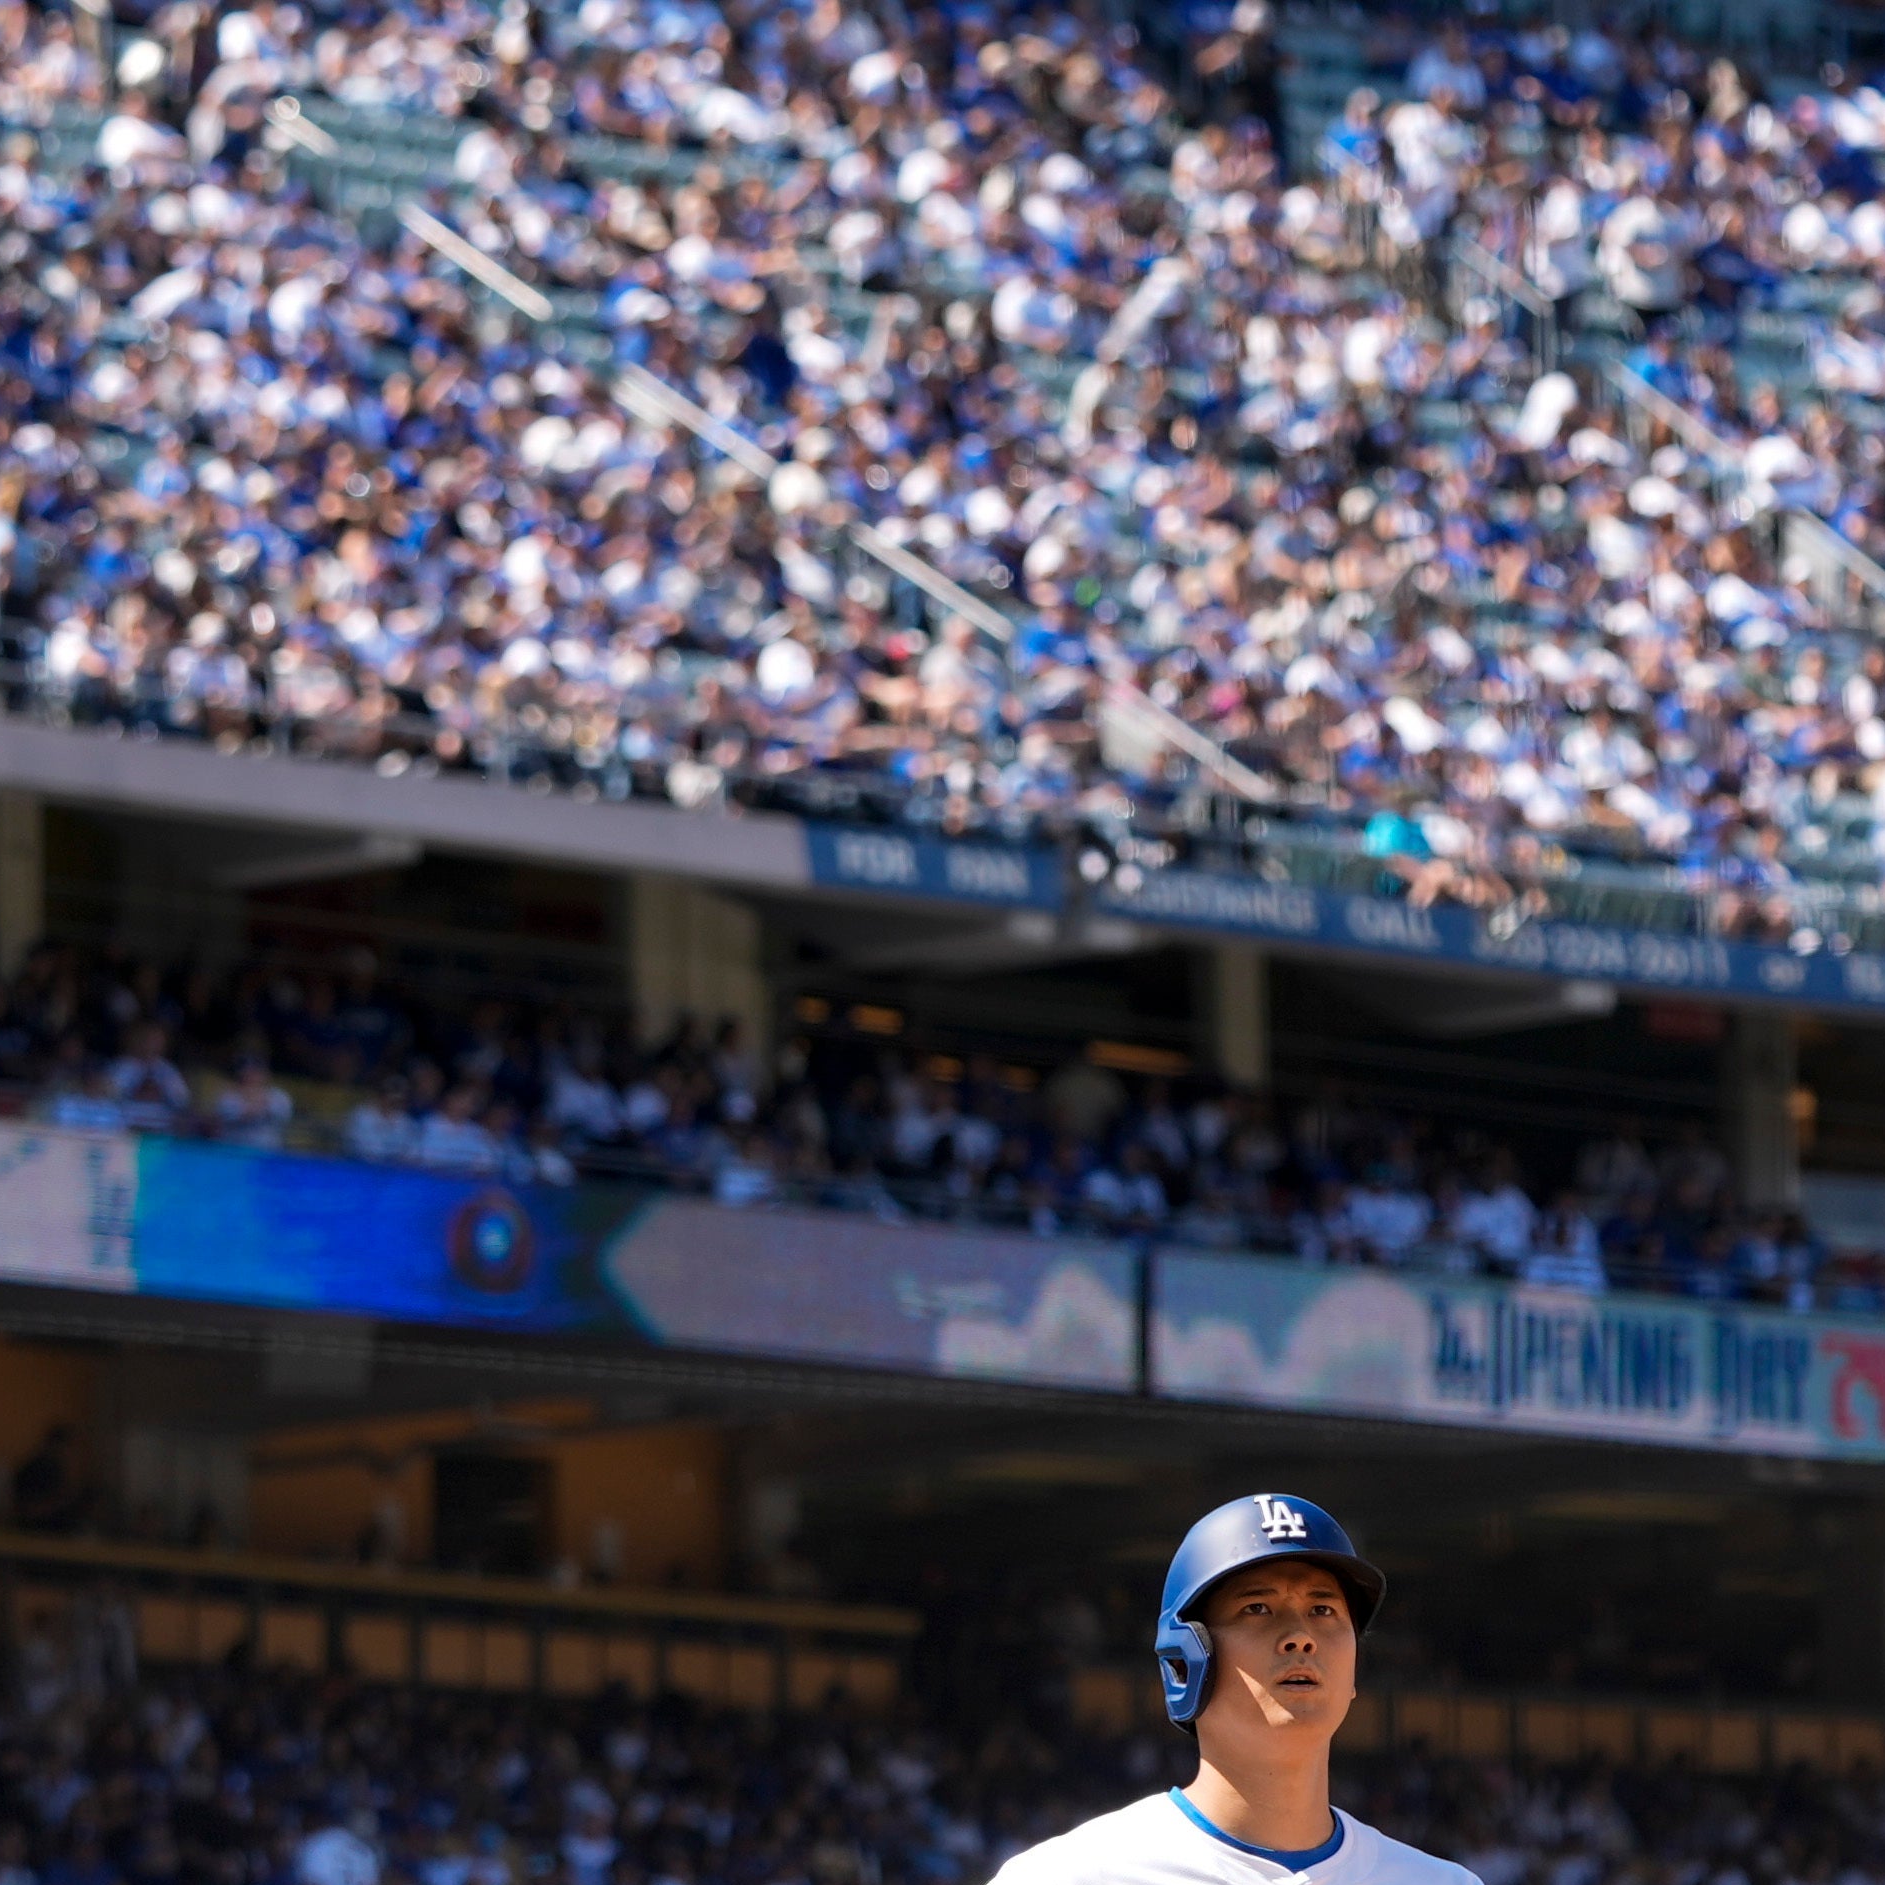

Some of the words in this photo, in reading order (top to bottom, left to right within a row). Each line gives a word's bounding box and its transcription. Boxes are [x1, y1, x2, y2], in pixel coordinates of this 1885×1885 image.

[1491, 1298, 1695, 1416] OPENING
[1712, 1310, 1813, 1437] DAY
[1254, 1494, 1307, 1538] LA
